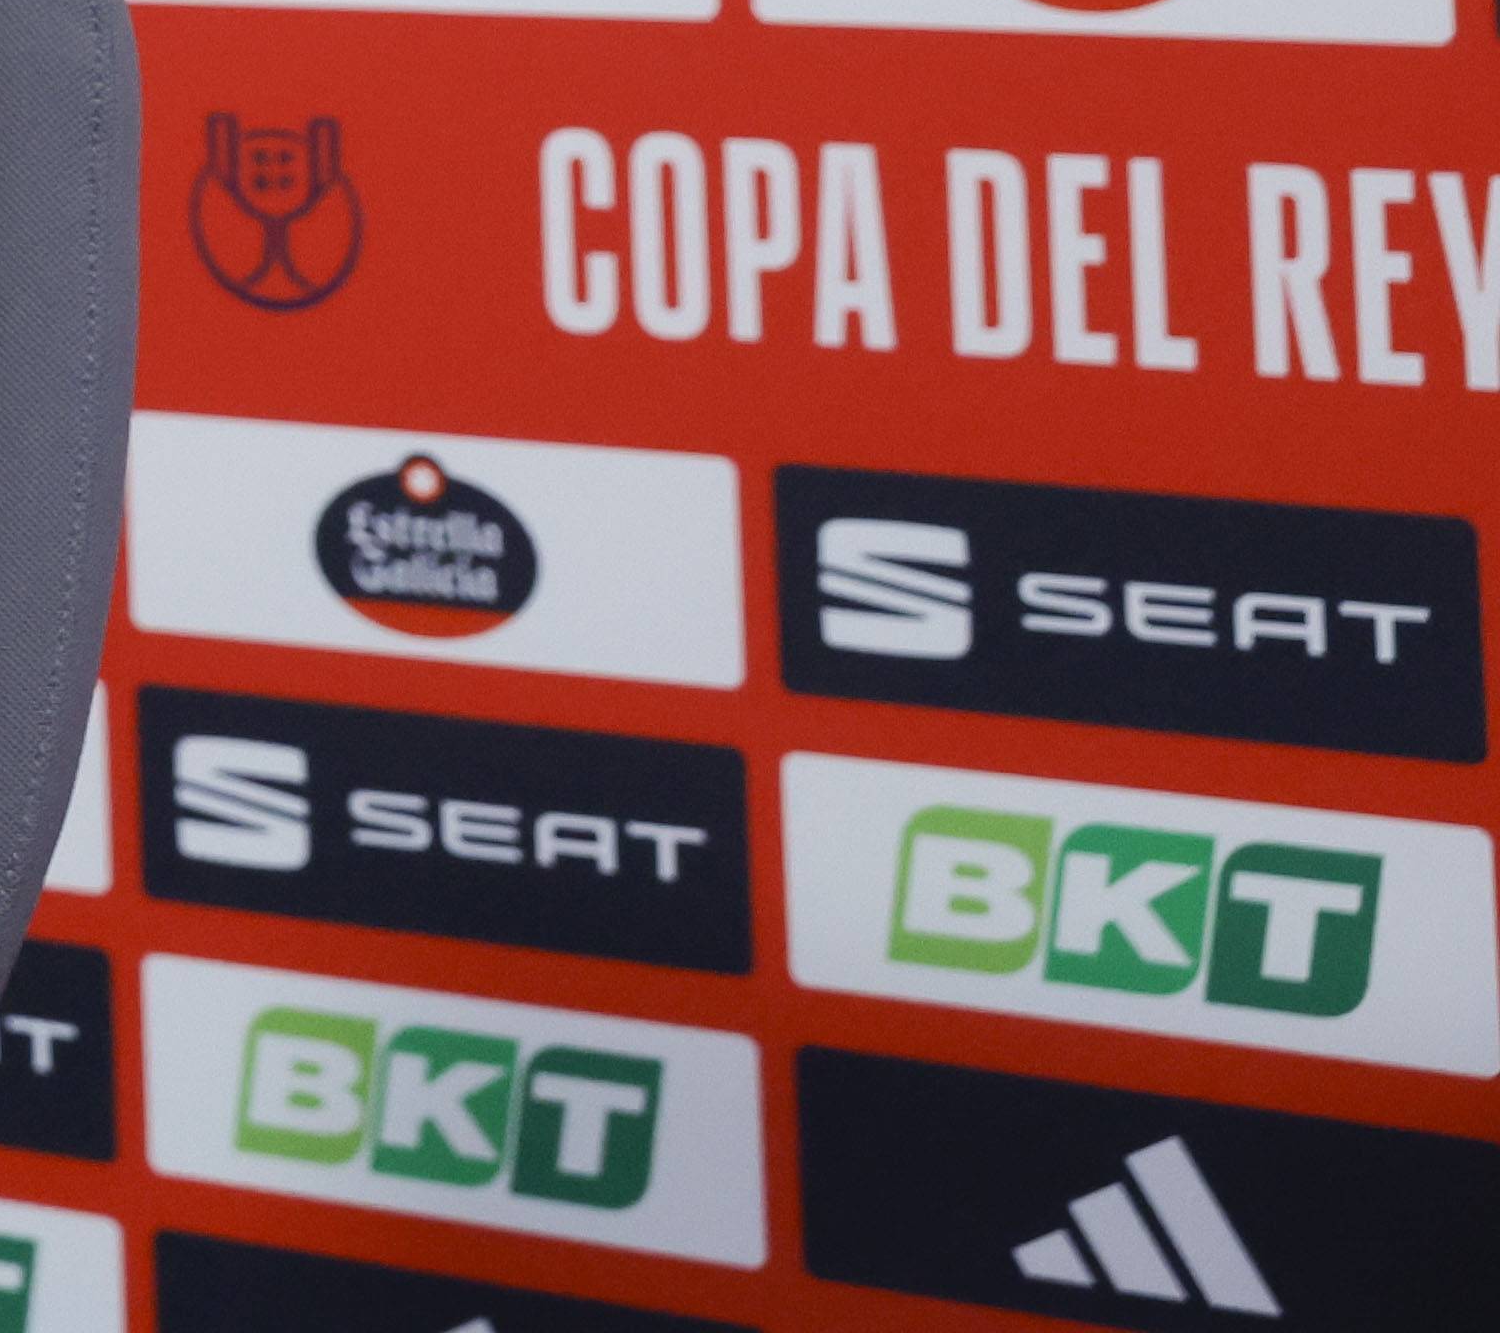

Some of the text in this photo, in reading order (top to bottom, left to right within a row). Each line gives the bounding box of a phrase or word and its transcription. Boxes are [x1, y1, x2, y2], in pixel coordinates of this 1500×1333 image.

[540, 128, 1500, 391] COPA DEL REY
[1018, 573, 1431, 663] SEAT
[349, 790, 706, 881] SEAT
[892, 814, 1378, 1013] BKT
[239, 1013, 655, 1205] BKT
